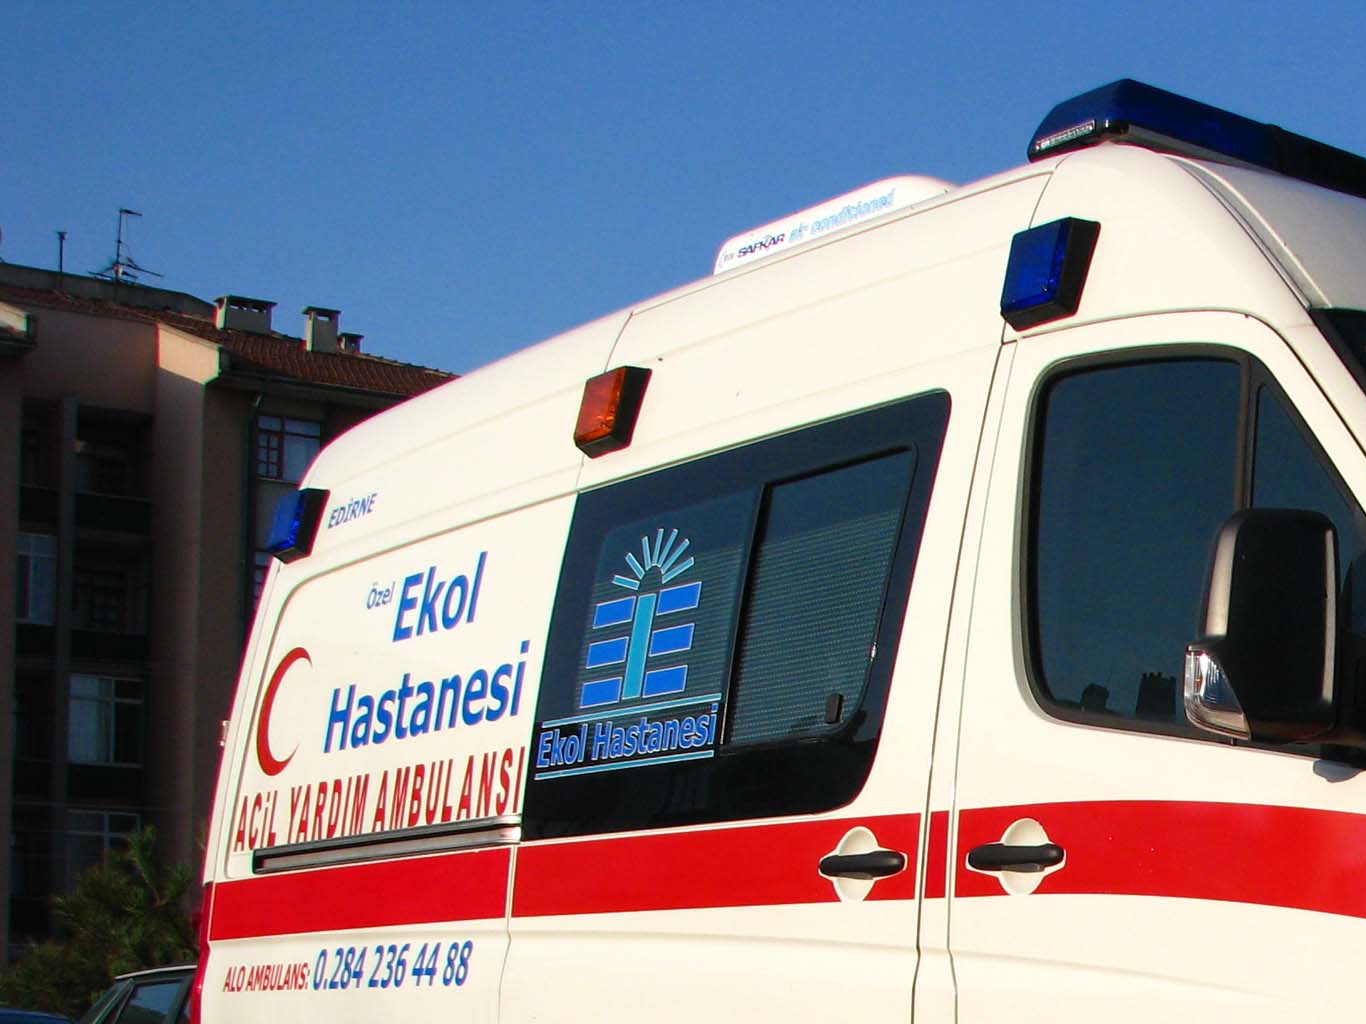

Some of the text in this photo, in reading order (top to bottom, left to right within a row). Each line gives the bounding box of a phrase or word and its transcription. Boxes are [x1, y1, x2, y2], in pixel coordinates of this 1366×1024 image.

[328, 493, 378, 529] EDİRNE
[366, 550, 489, 643] Özel Ekol
[323, 639, 531, 754] Hastanesi
[536, 703, 719, 769] Ekol Hastanesi
[287, 773, 370, 845] YARDIM
[372, 746, 526, 834] AMBULANSI
[223, 940, 474, 992] ALO AMBULANS: 0.284 236 44 88
